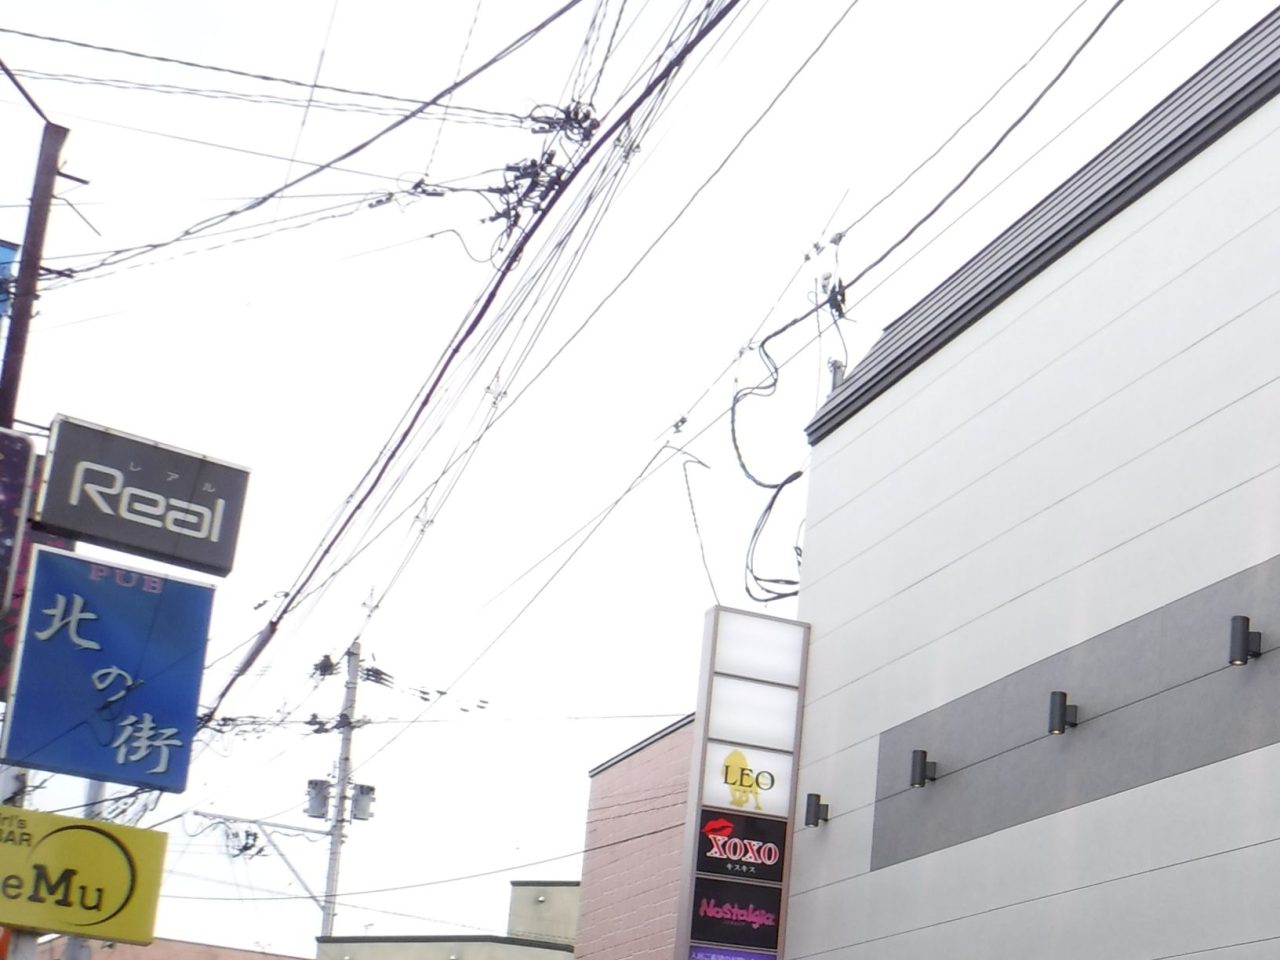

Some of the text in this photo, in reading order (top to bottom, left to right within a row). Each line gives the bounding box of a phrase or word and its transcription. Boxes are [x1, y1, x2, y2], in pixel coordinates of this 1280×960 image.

[69, 461, 226, 543] Real
[89, 562, 164, 594] PUB
[35, 592, 183, 774] 北の街
[723, 764, 775, 791] LEO
[706, 834, 780, 866] XOXO
